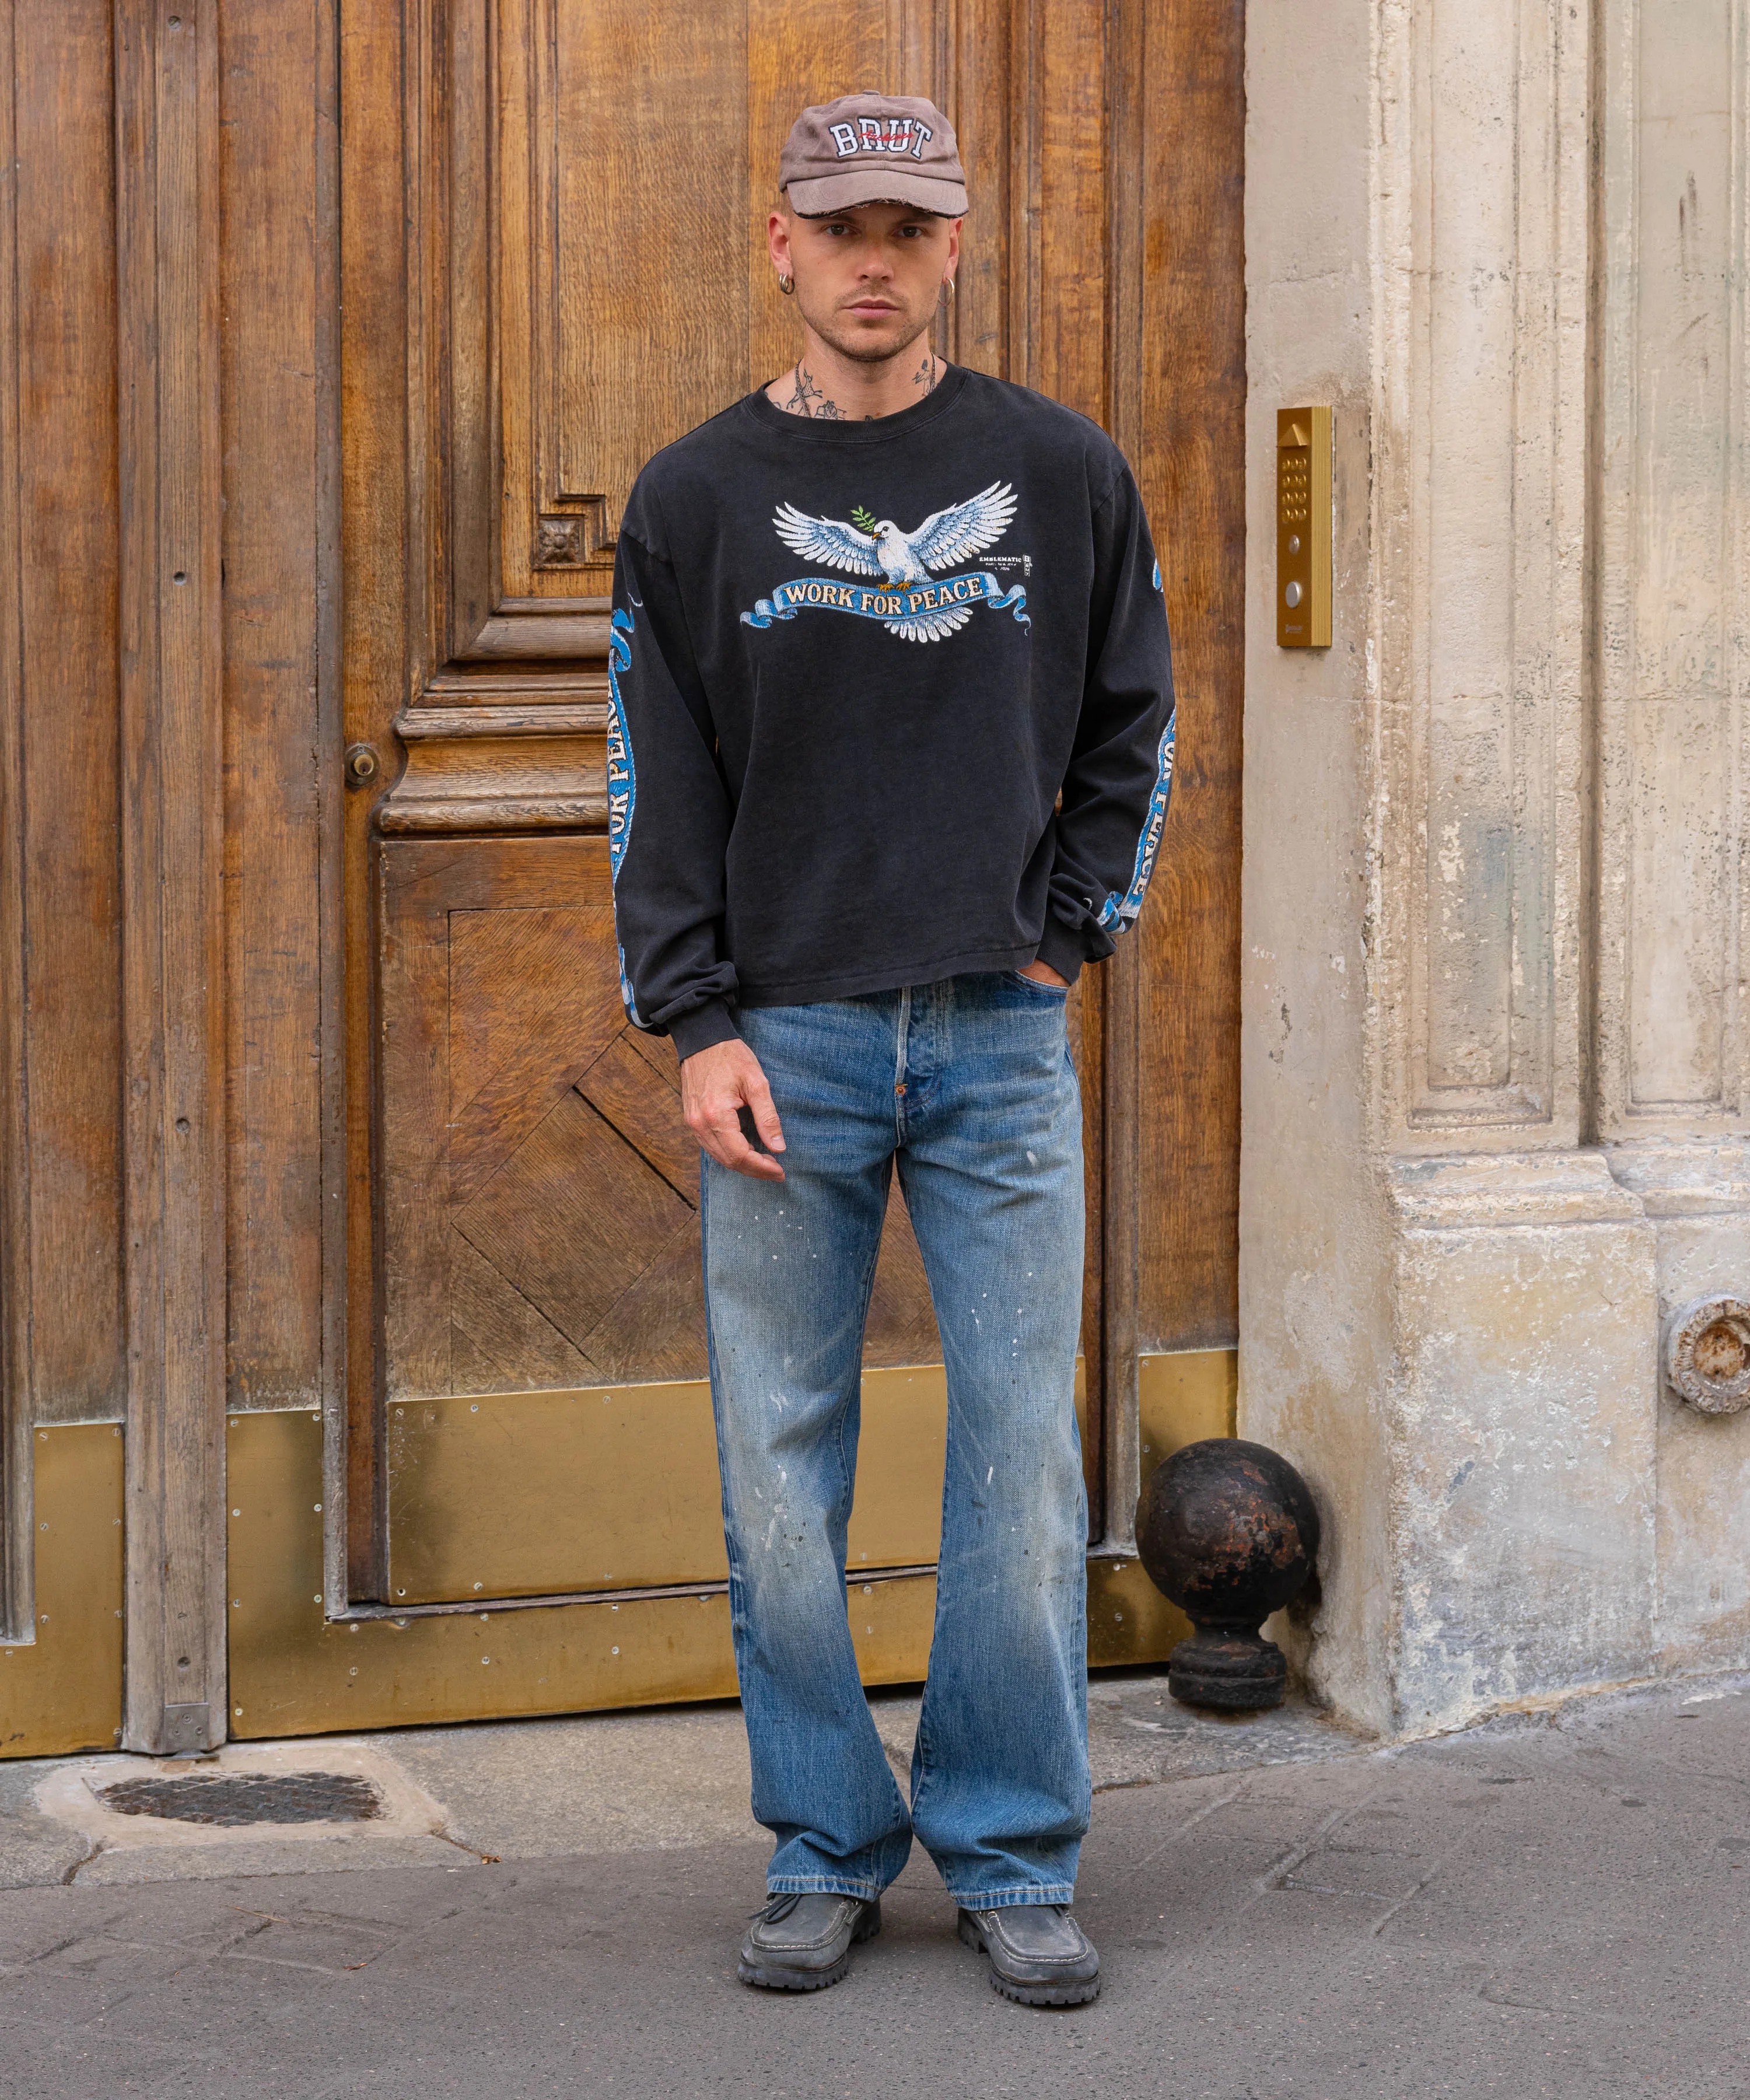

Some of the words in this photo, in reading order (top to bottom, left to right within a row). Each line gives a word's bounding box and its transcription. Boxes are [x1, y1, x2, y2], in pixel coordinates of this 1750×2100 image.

[828, 117, 933, 159] BRUT
[858, 130, 914, 141] Archives
[783, 583, 856, 609] WORK
[860, 593, 904, 615] FOR
[905, 577, 984, 614] PEACE
